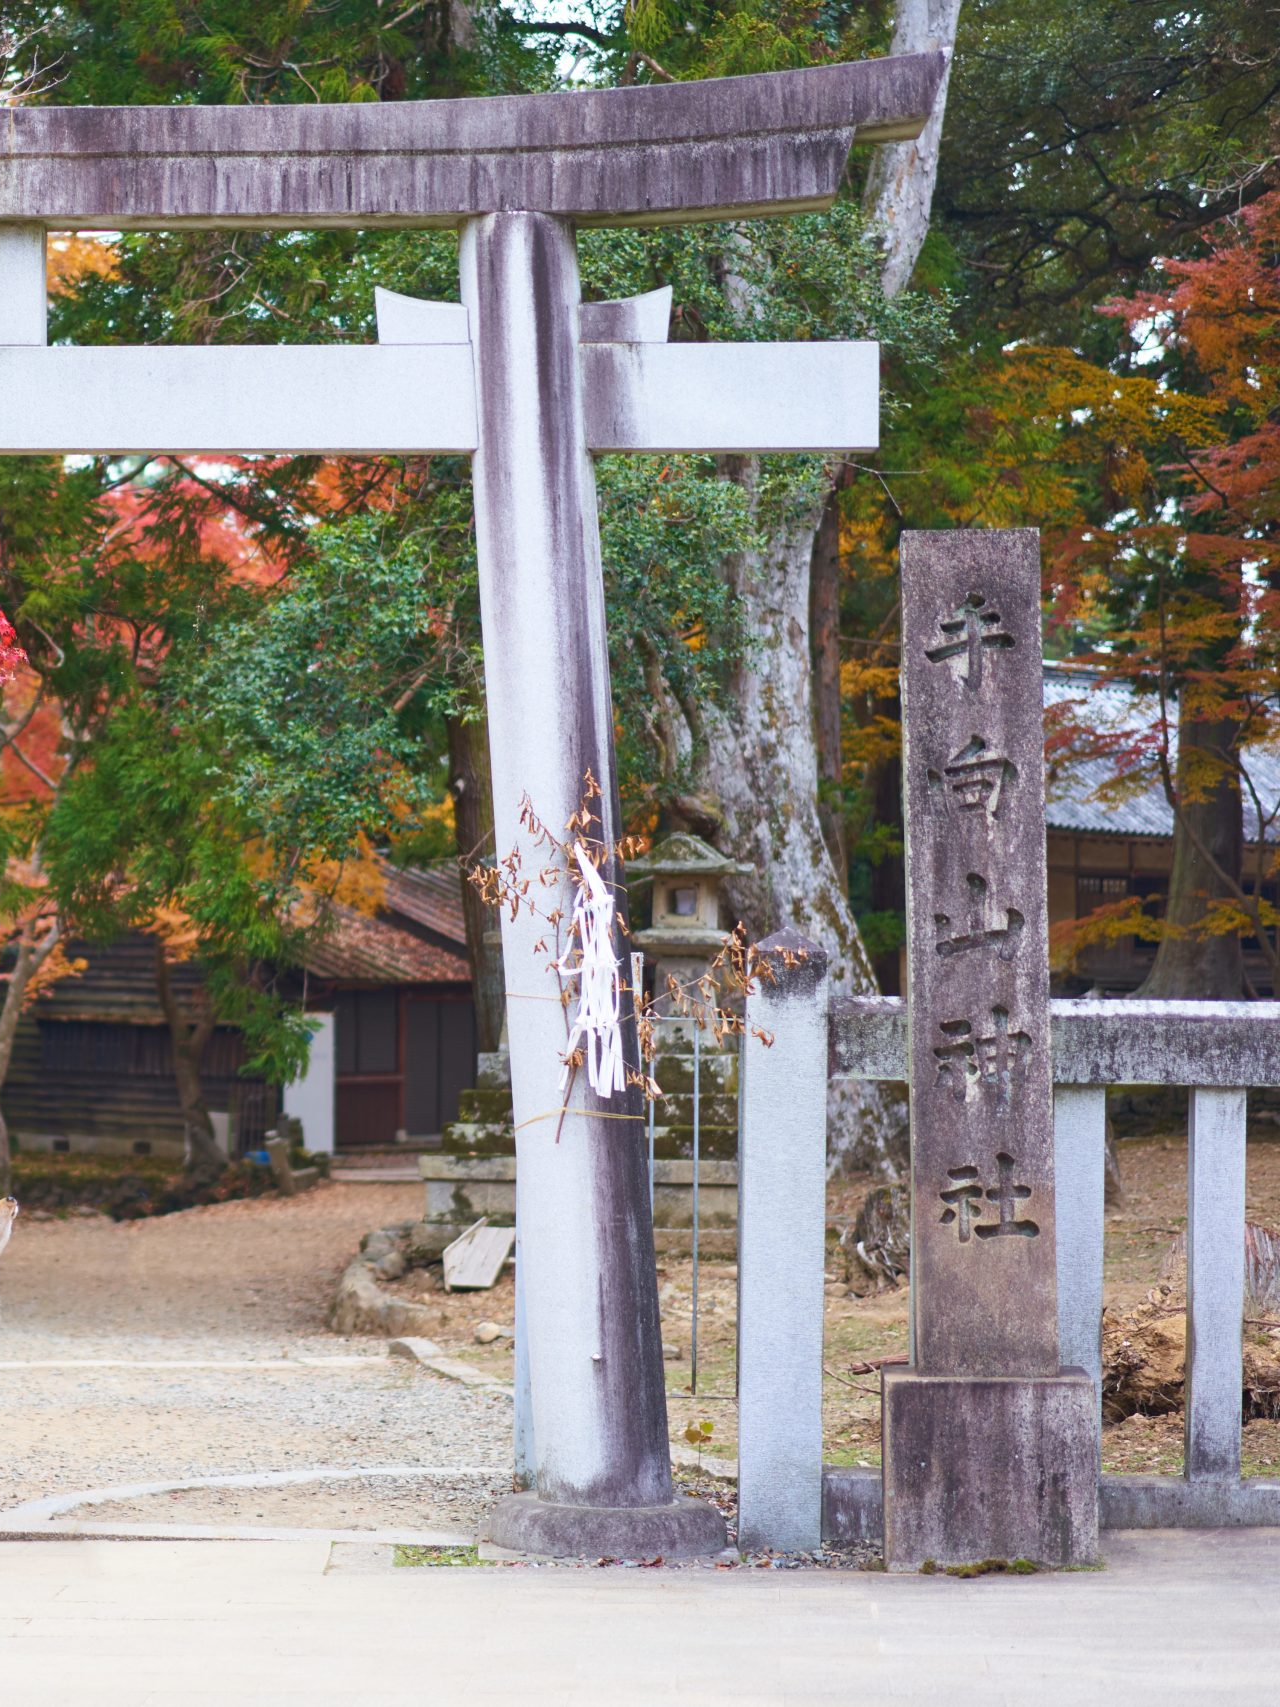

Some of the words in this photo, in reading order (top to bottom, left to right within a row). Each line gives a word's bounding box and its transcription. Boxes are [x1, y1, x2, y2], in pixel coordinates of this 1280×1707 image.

[925, 592, 1040, 1243] 手向山神社
